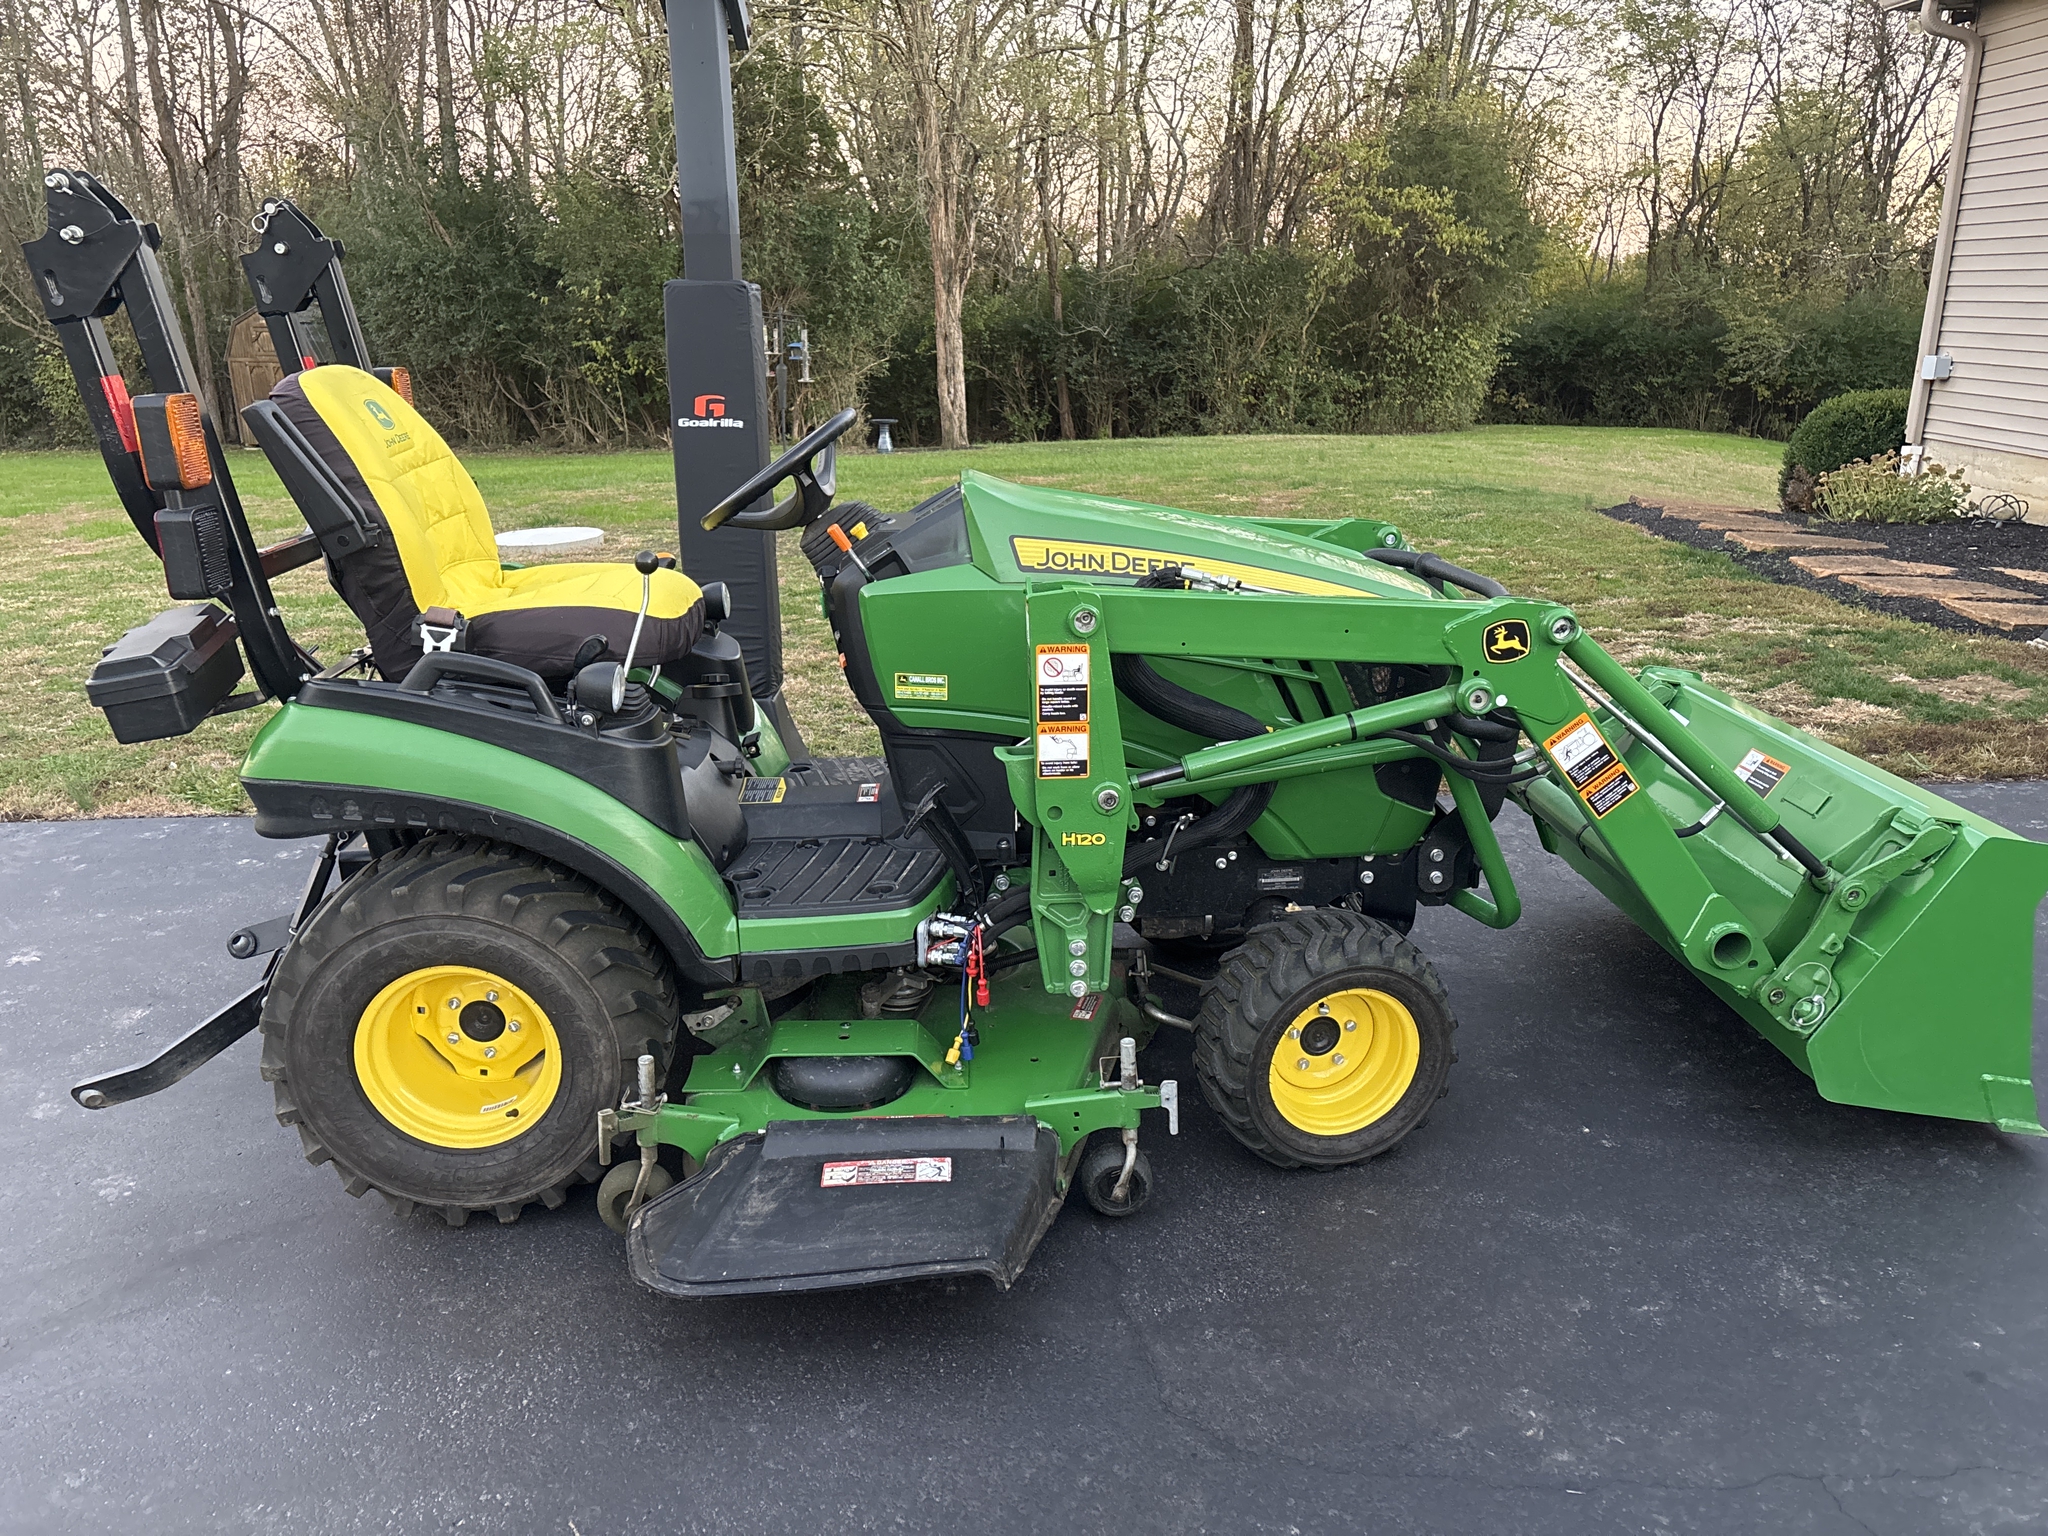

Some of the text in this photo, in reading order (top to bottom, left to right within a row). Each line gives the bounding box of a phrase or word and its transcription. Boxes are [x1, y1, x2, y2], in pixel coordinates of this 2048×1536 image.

[677, 417, 744, 429] Goalrilla
[383, 436, 398, 449] JOHN
[1036, 547, 1105, 571] JOHN
[1046, 645, 1088, 653] WARNING
[1047, 725, 1087, 733] WARNING
[1556, 718, 1584, 741] WARNING
[1592, 768, 1620, 790] WARNING
[1061, 832, 1106, 847] H120
